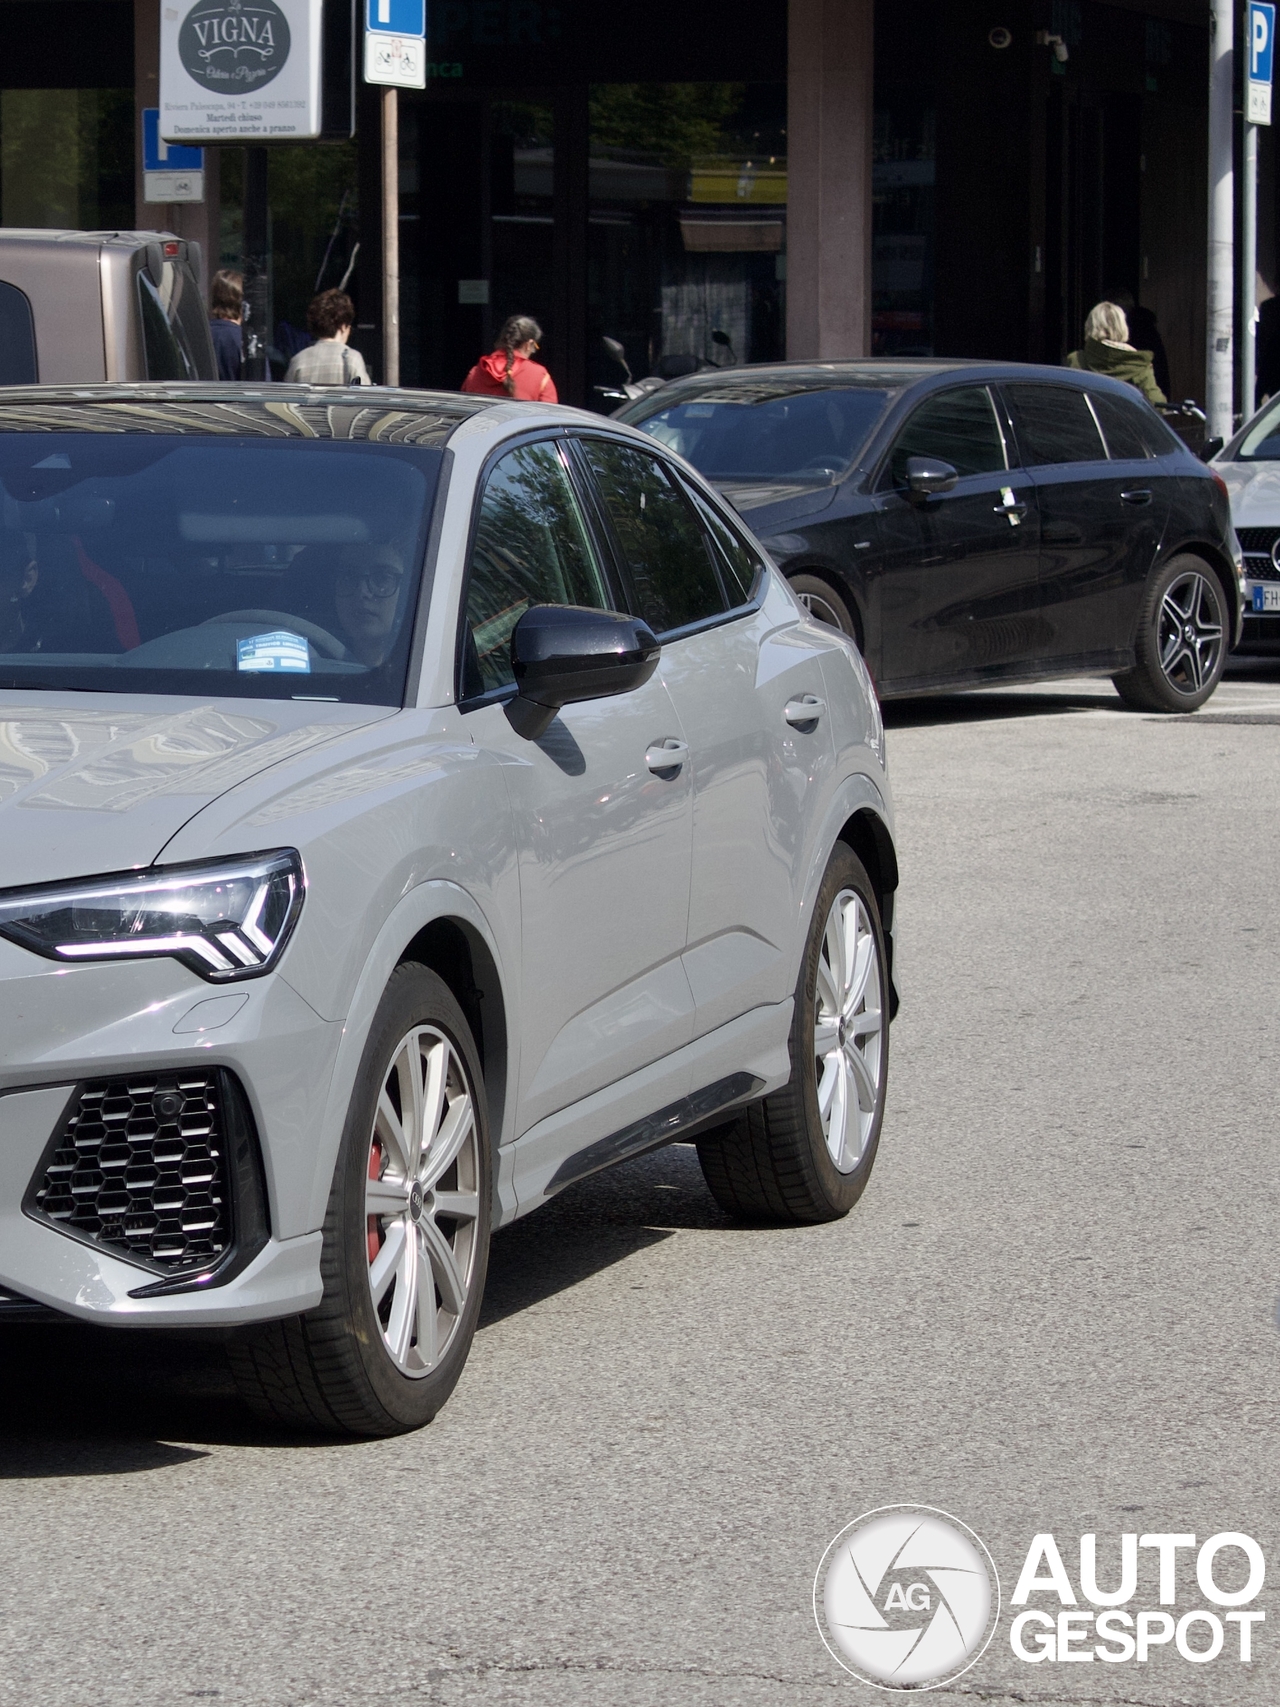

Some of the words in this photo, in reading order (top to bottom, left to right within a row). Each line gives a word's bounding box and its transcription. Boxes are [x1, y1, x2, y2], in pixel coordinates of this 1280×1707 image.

[192, 16, 275, 46] VIGNA
[1252, 10, 1268, 74] P
[238, 113, 262, 122] chiuso
[174, 125, 211, 134] Domenica
[212, 126, 237, 135] aperto
[239, 125, 260, 133] anche
[269, 125, 296, 134] pranzo
